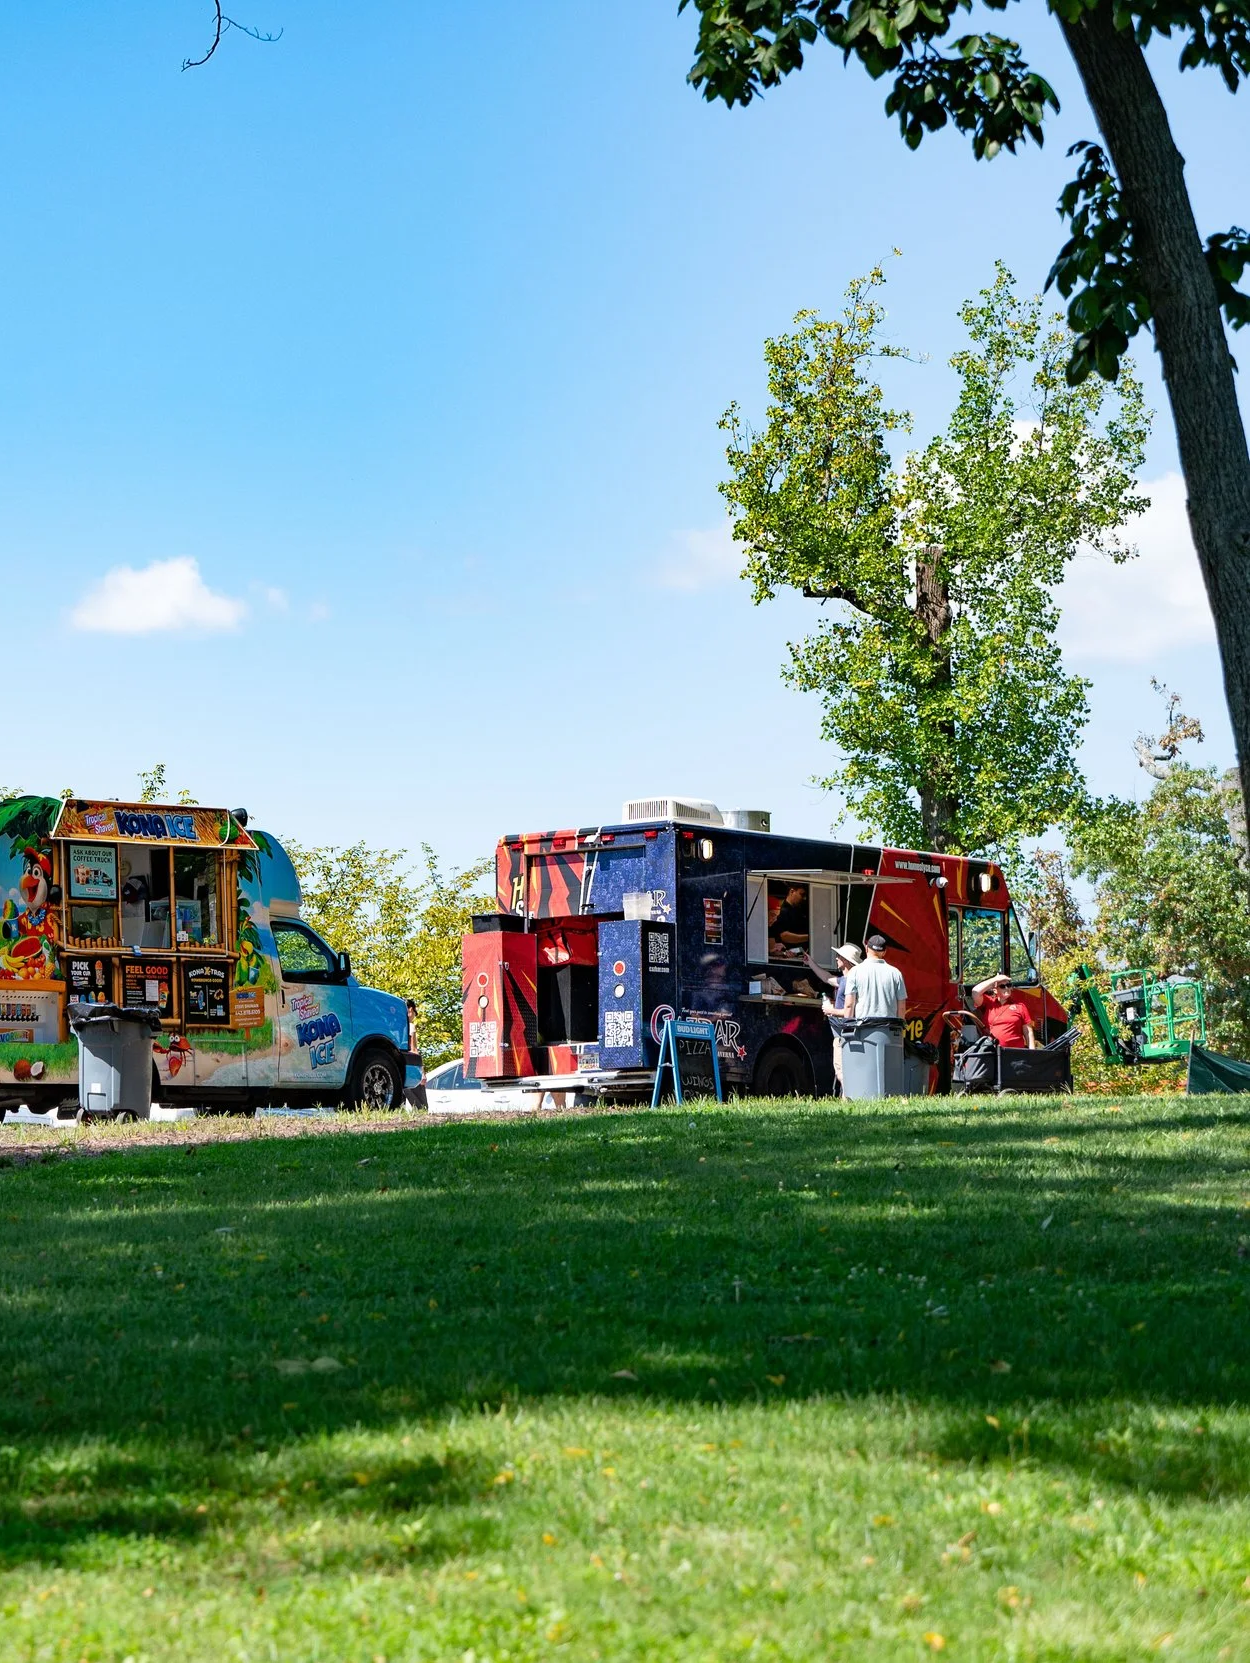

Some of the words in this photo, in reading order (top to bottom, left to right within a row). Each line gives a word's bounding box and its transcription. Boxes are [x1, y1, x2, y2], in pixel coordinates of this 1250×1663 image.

[114, 810, 168, 839] KONA
[164, 814, 197, 840] ICE
[72, 961, 89, 971] PICK
[125, 965, 144, 974] FEEL
[145, 966, 168, 975] GOOD
[296, 1013, 342, 1047] KONA
[677, 1025, 691, 1033] BUD
[691, 1026, 709, 1035] LIGHT
[309, 1039, 335, 1070] ICE
[679, 1039, 711, 1055] PIZZA
[680, 1074, 715, 1090] WINGS
